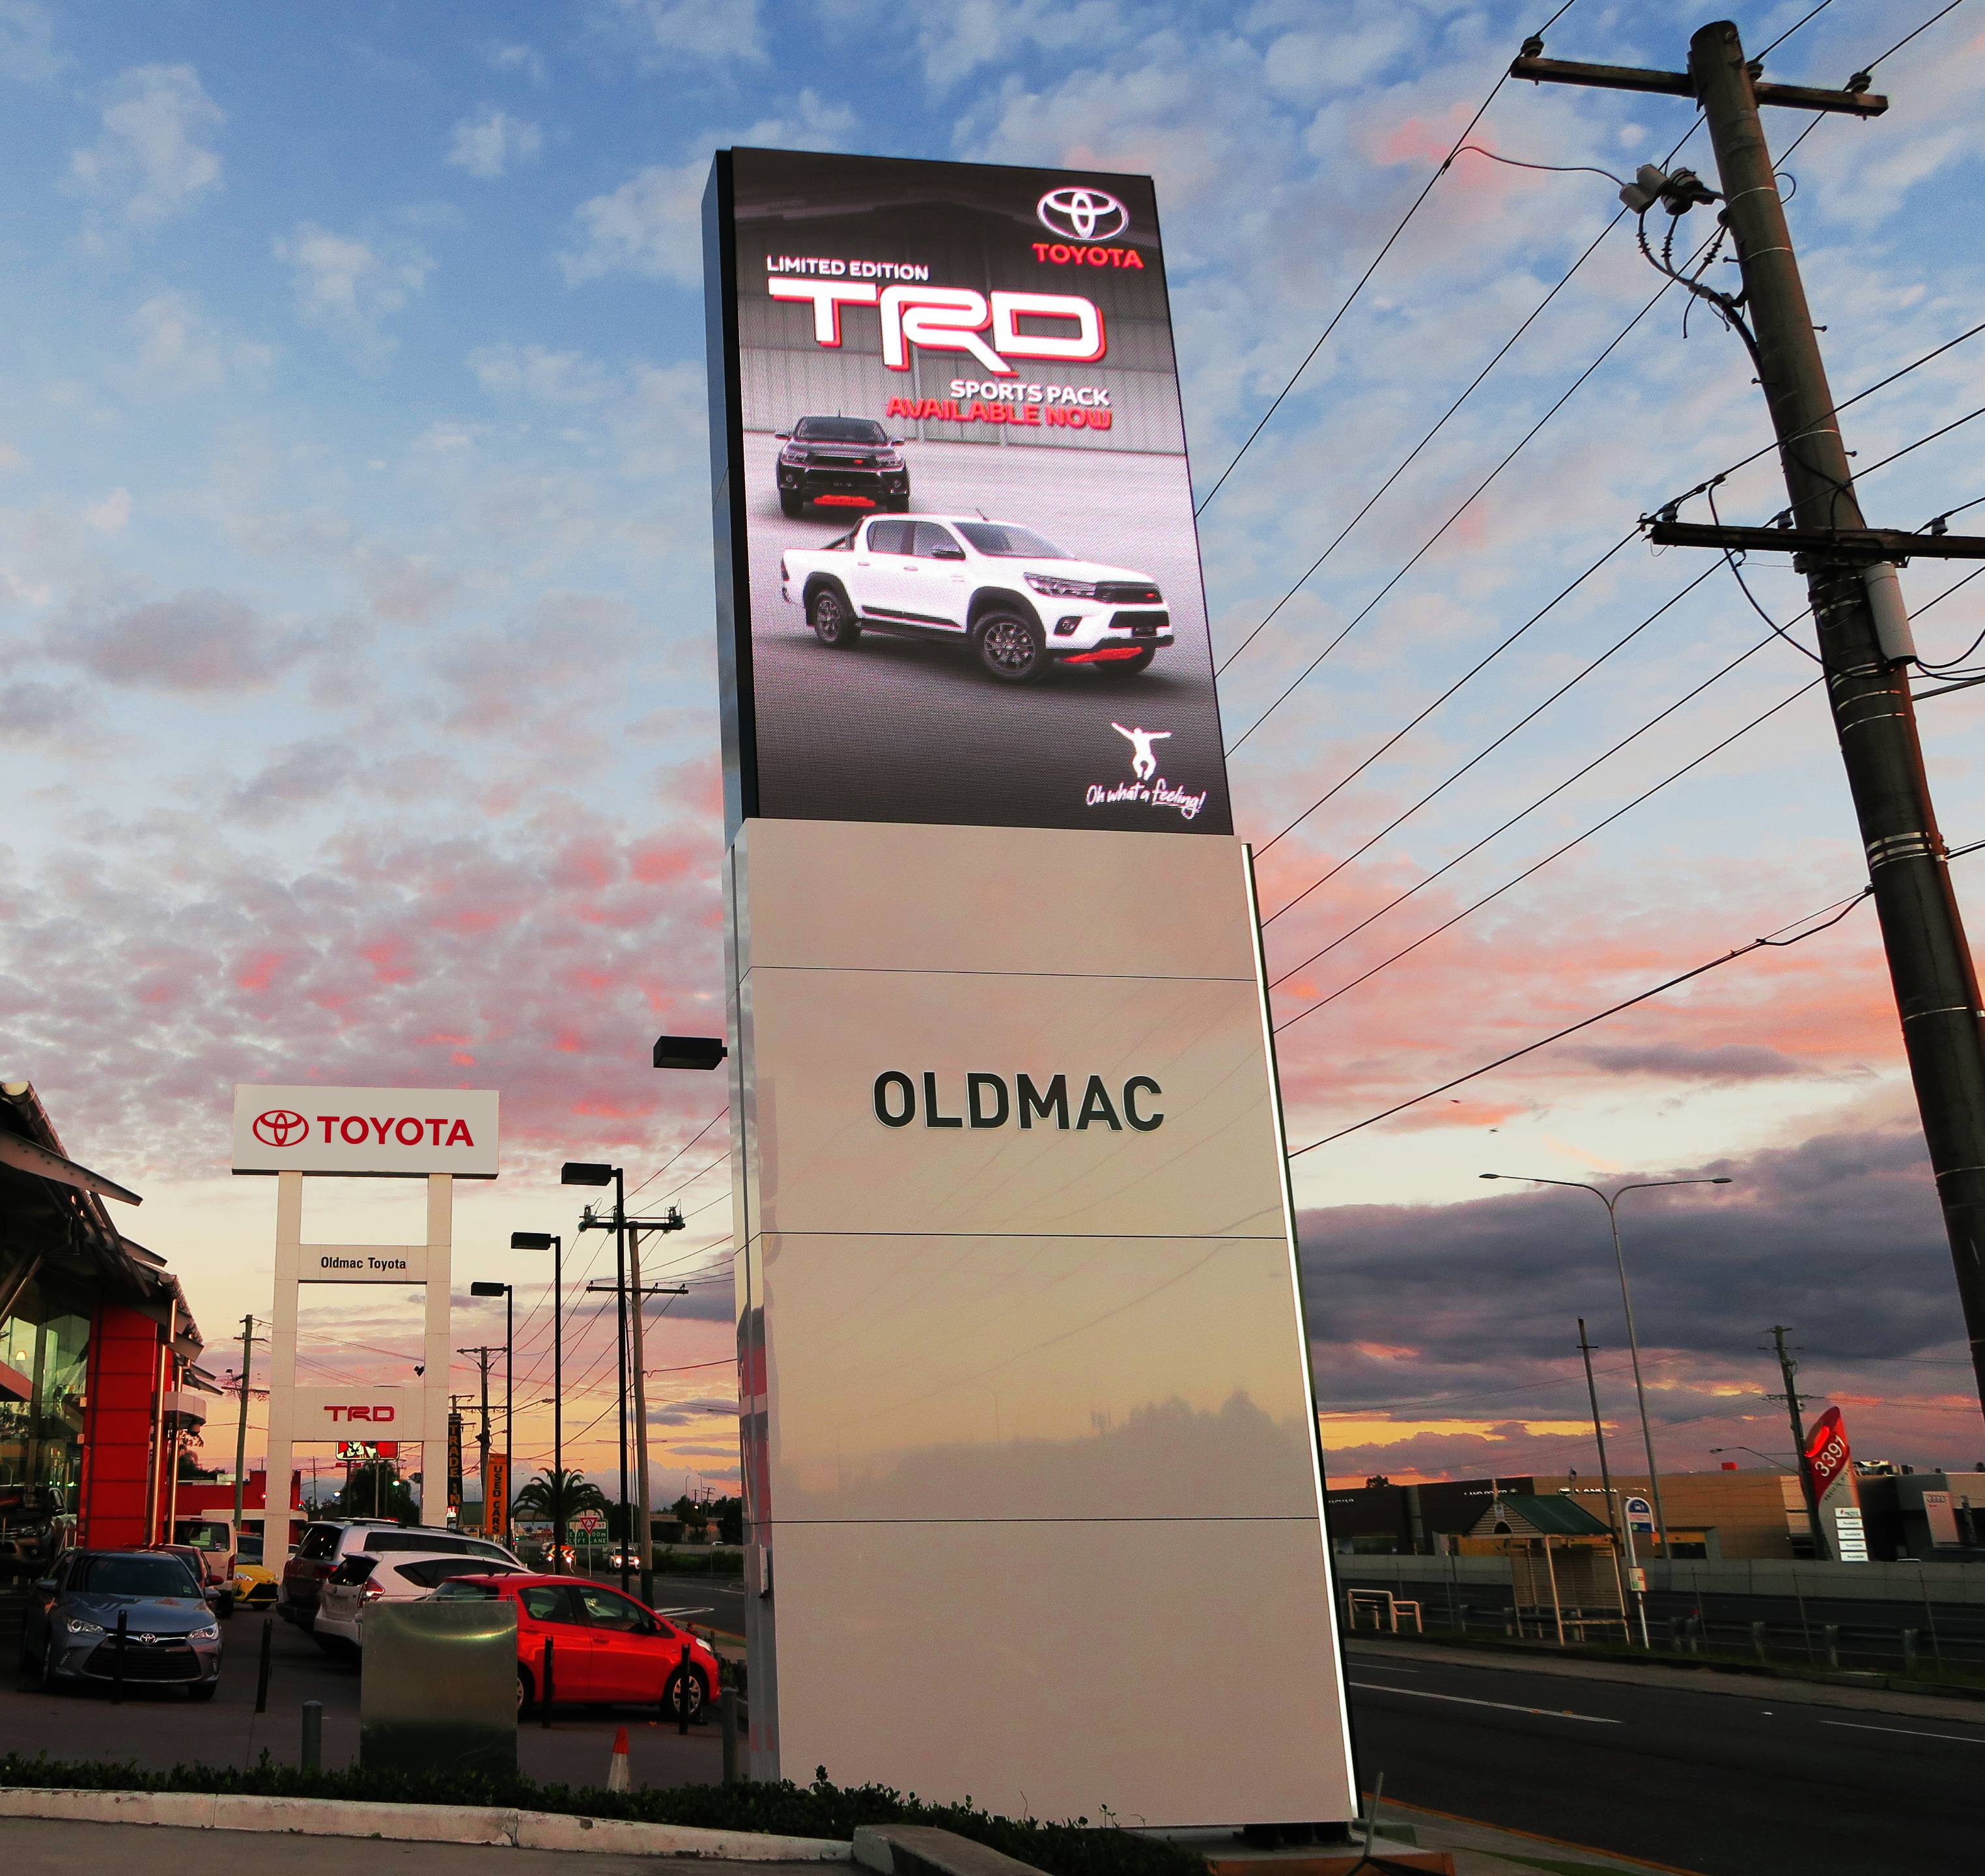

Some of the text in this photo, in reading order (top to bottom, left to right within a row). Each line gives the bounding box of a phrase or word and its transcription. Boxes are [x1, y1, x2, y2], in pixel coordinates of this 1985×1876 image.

[767, 256, 929, 281] LIMITED EDITION
[1032, 242, 1144, 268] TOYOTA
[768, 277, 1107, 377] TRD
[950, 378, 1110, 406] SPORTS PACK
[886, 395, 1112, 431] AVAILABLE NOW
[1086, 778, 1207, 819] Oh what a feeling!
[873, 1070, 1164, 1133] OLDMAC
[317, 1116, 474, 1146] TOYOTA
[321, 1257, 406, 1271] Oldmac Toyota
[324, 1406, 394, 1421] TRD
[492, 1466, 503, 1497] USED
[492, 1501, 501, 1533] CARS
